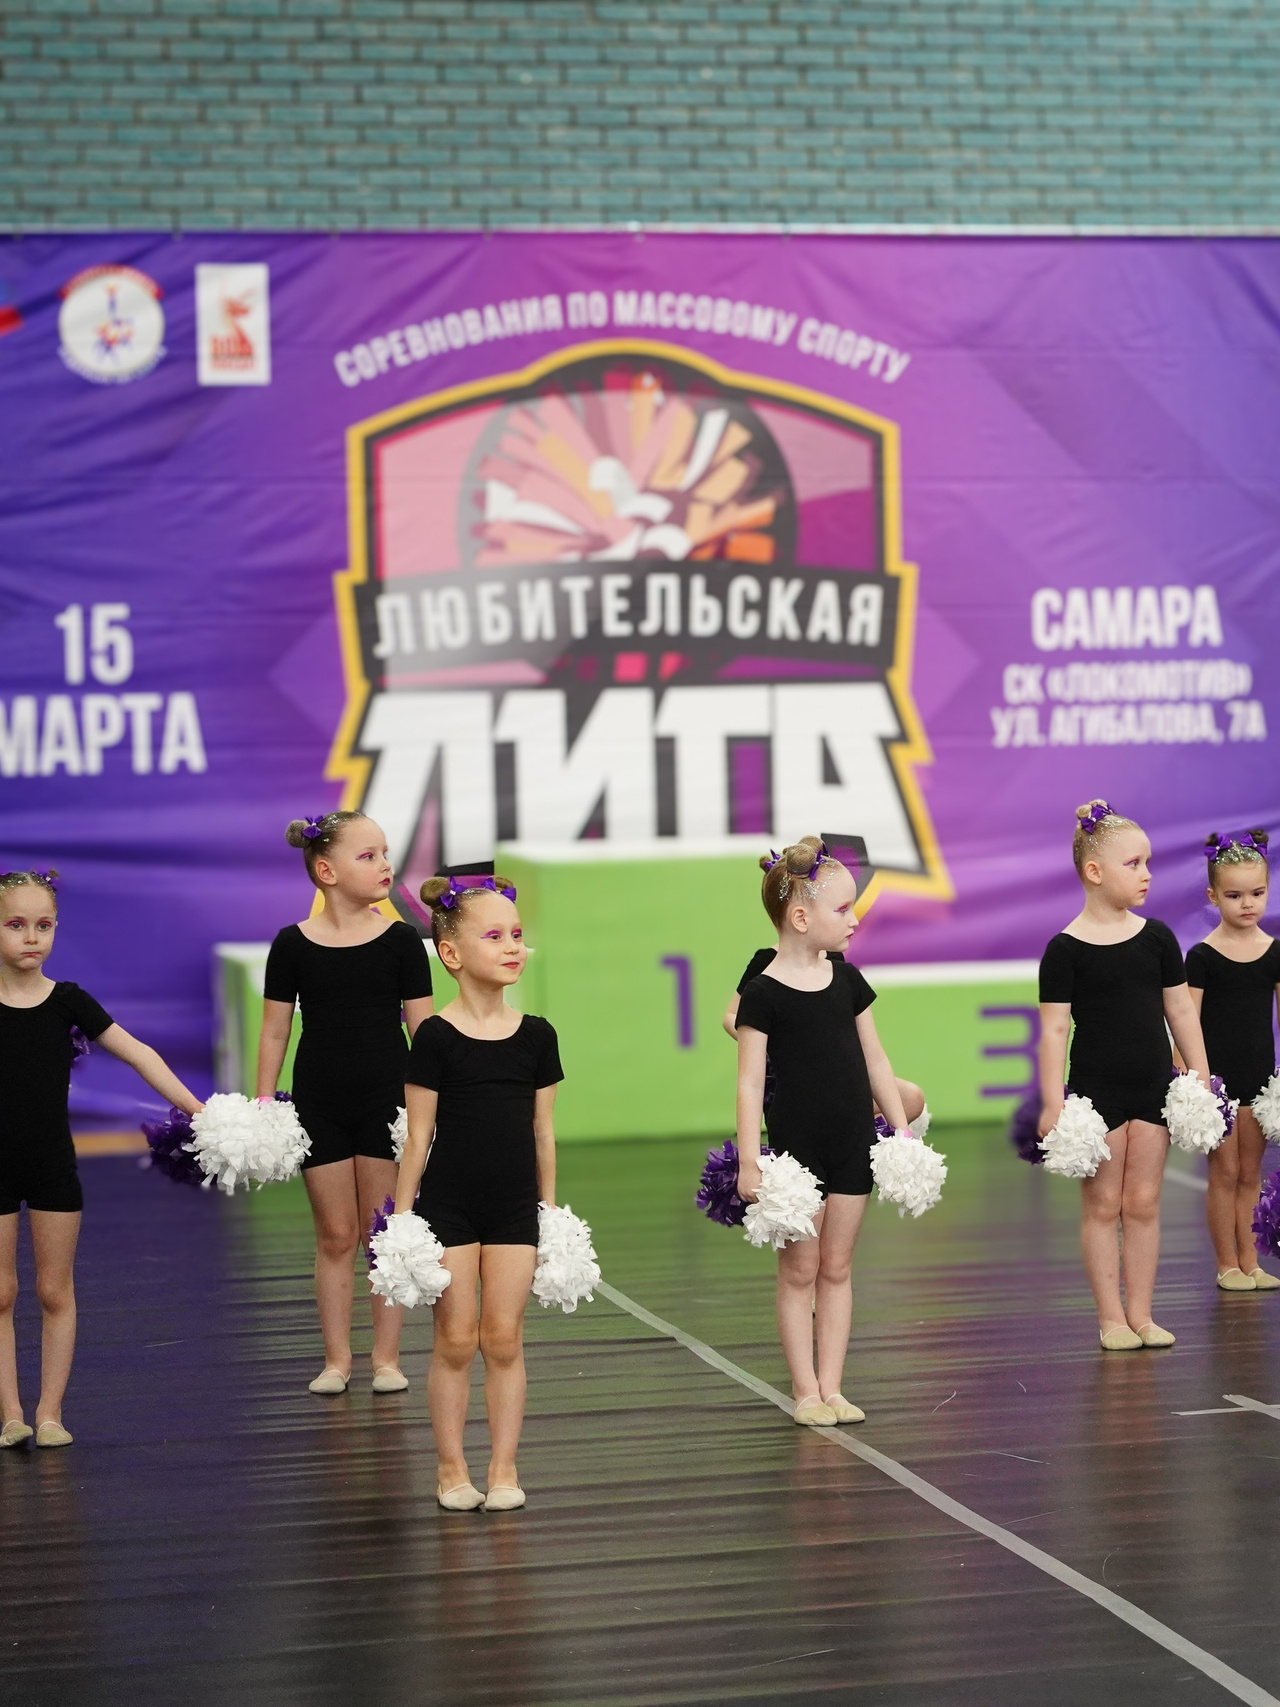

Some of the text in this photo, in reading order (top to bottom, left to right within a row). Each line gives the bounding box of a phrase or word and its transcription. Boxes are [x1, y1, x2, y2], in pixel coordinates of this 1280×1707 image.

[333, 290, 911, 387] СОРЕВНОВАНИЯ ПО МАССОВОМУ СПОРТУ
[55, 603, 133, 685] 15
[373, 573, 884, 657] ЛЮБИТЕЛЬСКАЯ
[1031, 584, 1223, 651] САМАРА
[990, 699, 1267, 748] УЛ. АГИБАЛОВА, 7А
[1003, 663, 1045, 705] СК
[0, 691, 207, 778] МАРТА
[360, 683, 924, 869] ЛИГА
[660, 953, 696, 1050] 1
[980, 1005, 1042, 1099] 3
